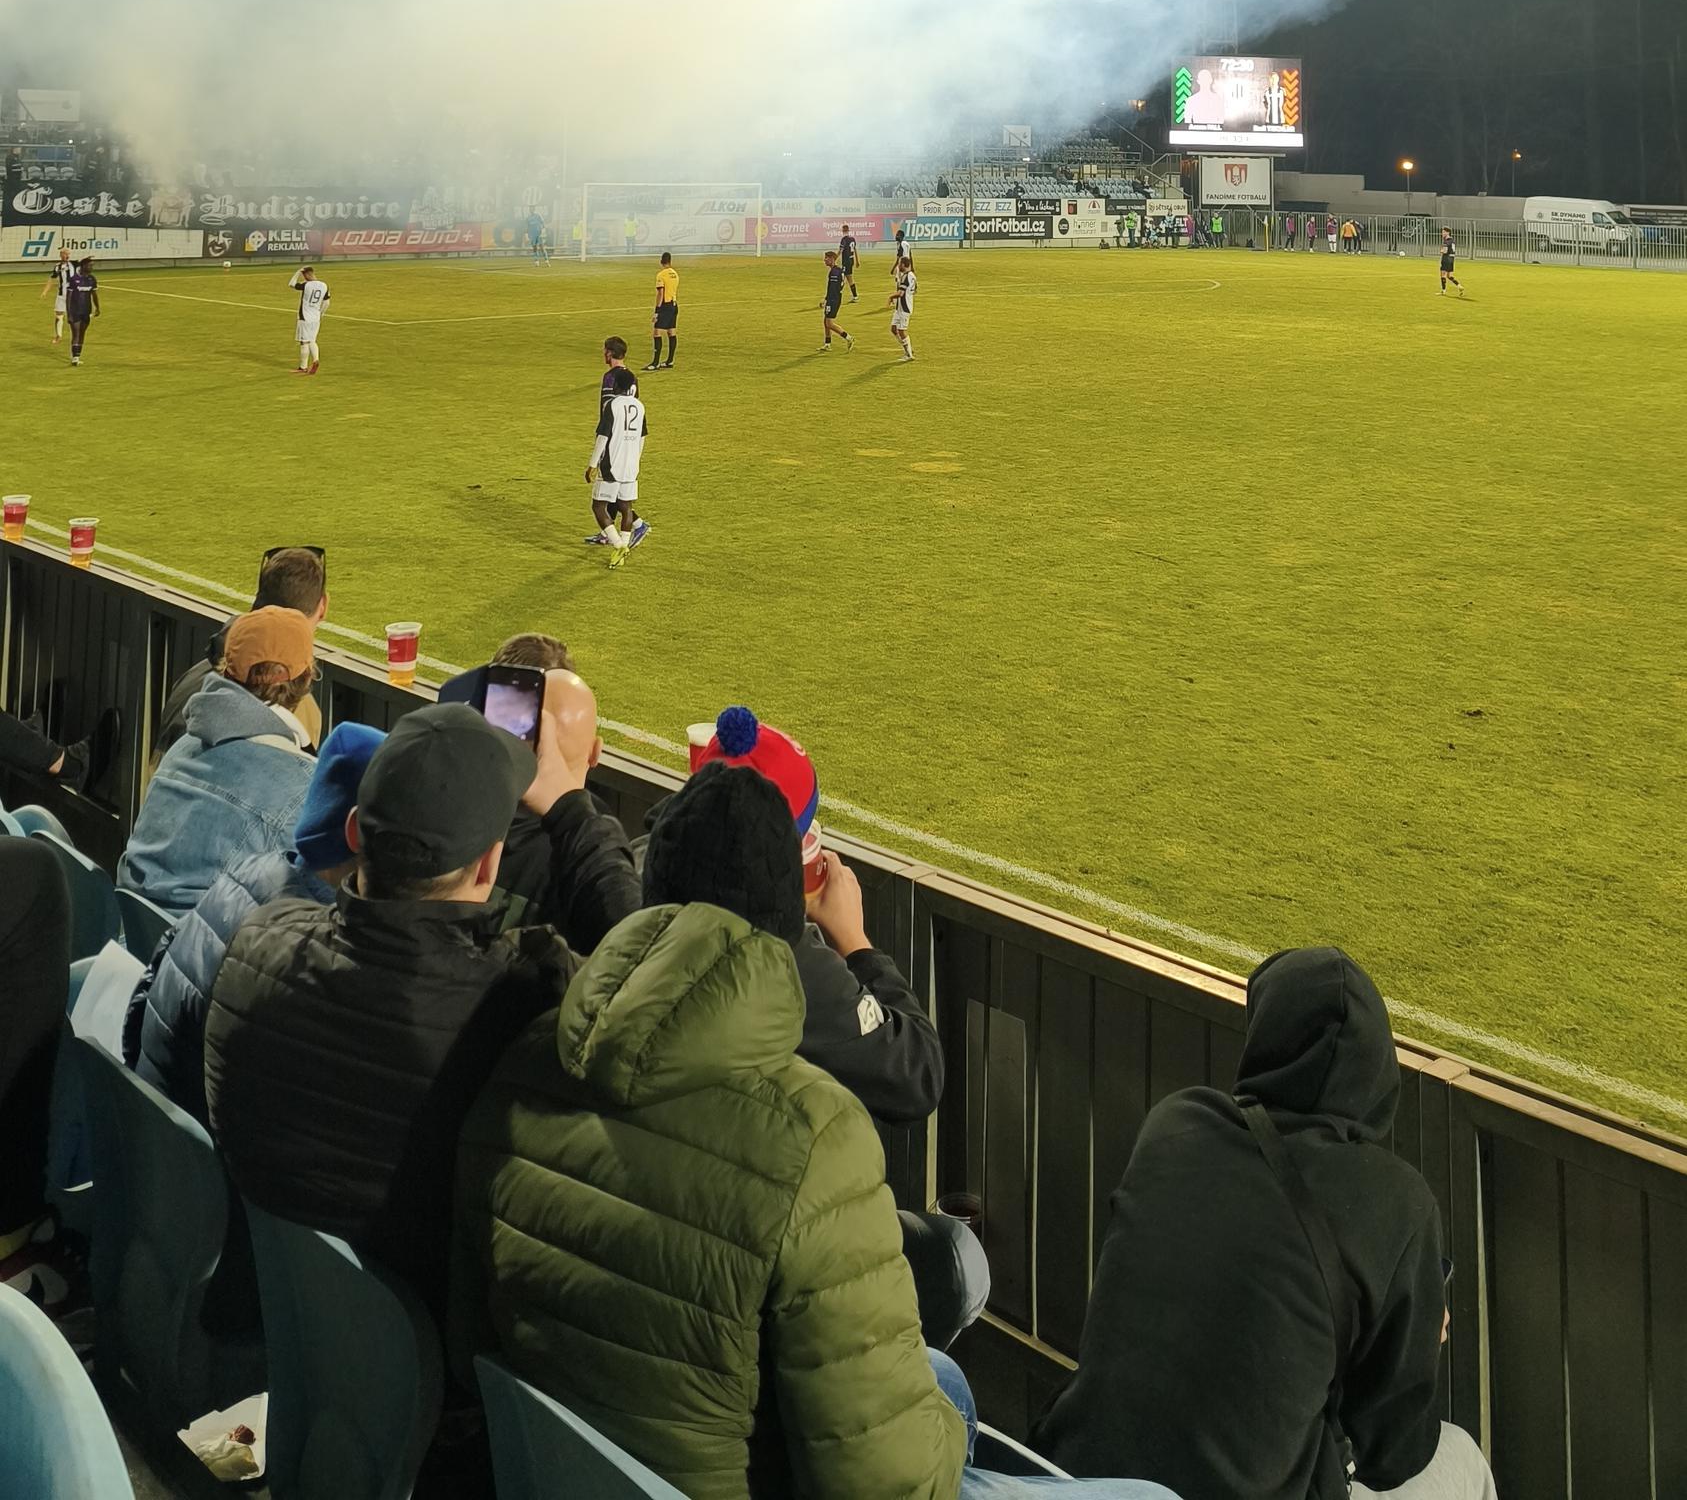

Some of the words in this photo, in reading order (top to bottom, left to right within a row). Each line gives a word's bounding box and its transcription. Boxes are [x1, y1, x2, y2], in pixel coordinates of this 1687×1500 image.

[1206, 192, 1237, 201] FANDÍME
[1237, 193, 1267, 201] FOTBALU
[13, 183, 145, 218] České
[199, 193, 401, 228] Budějovice
[923, 206, 942, 214] PRIOR
[947, 206, 964, 214] PRIOR
[771, 222, 809, 234] Starnet
[905, 219, 960, 240] Tipsport
[965, 217, 1046, 234] SportFotbal.cz
[57, 238, 119, 250] JihoTech
[267, 242, 310, 252] REKLAMA
[309, 289, 322, 304] 19
[623, 404, 638, 432] 12
